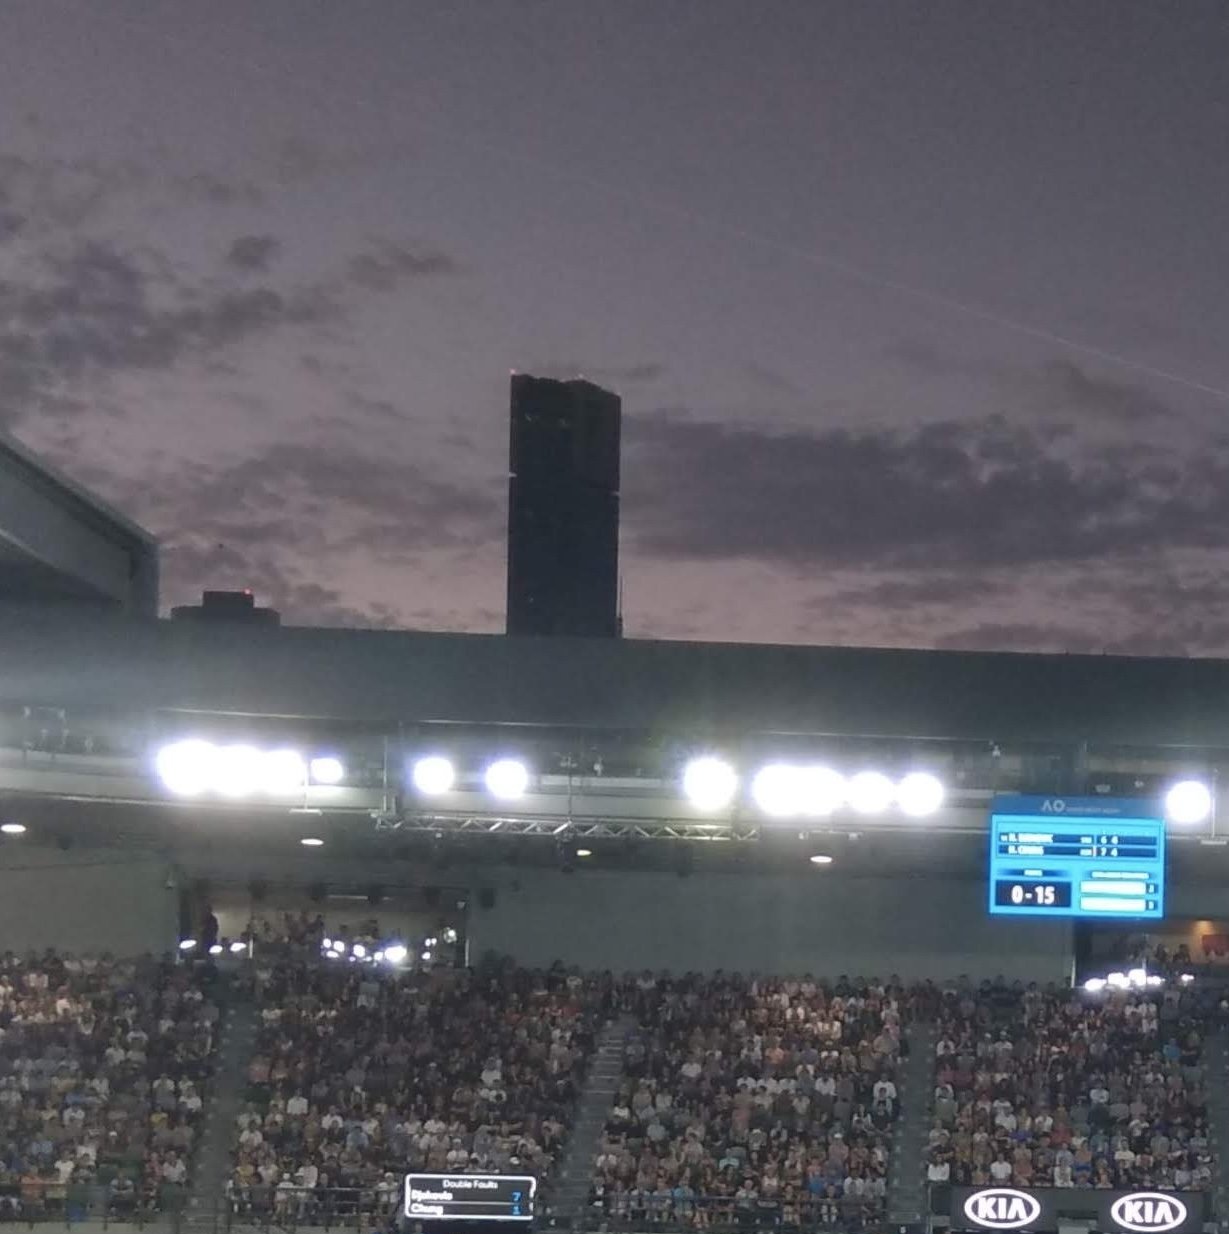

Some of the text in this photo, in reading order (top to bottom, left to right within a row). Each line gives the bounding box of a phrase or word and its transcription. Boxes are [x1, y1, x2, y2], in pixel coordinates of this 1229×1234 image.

[442, 1179, 499, 1189] Double Faults
[512, 1191, 521, 1201] 7
[978, 1197, 1028, 1220] KIA
[1124, 1200, 1174, 1223] KIA
